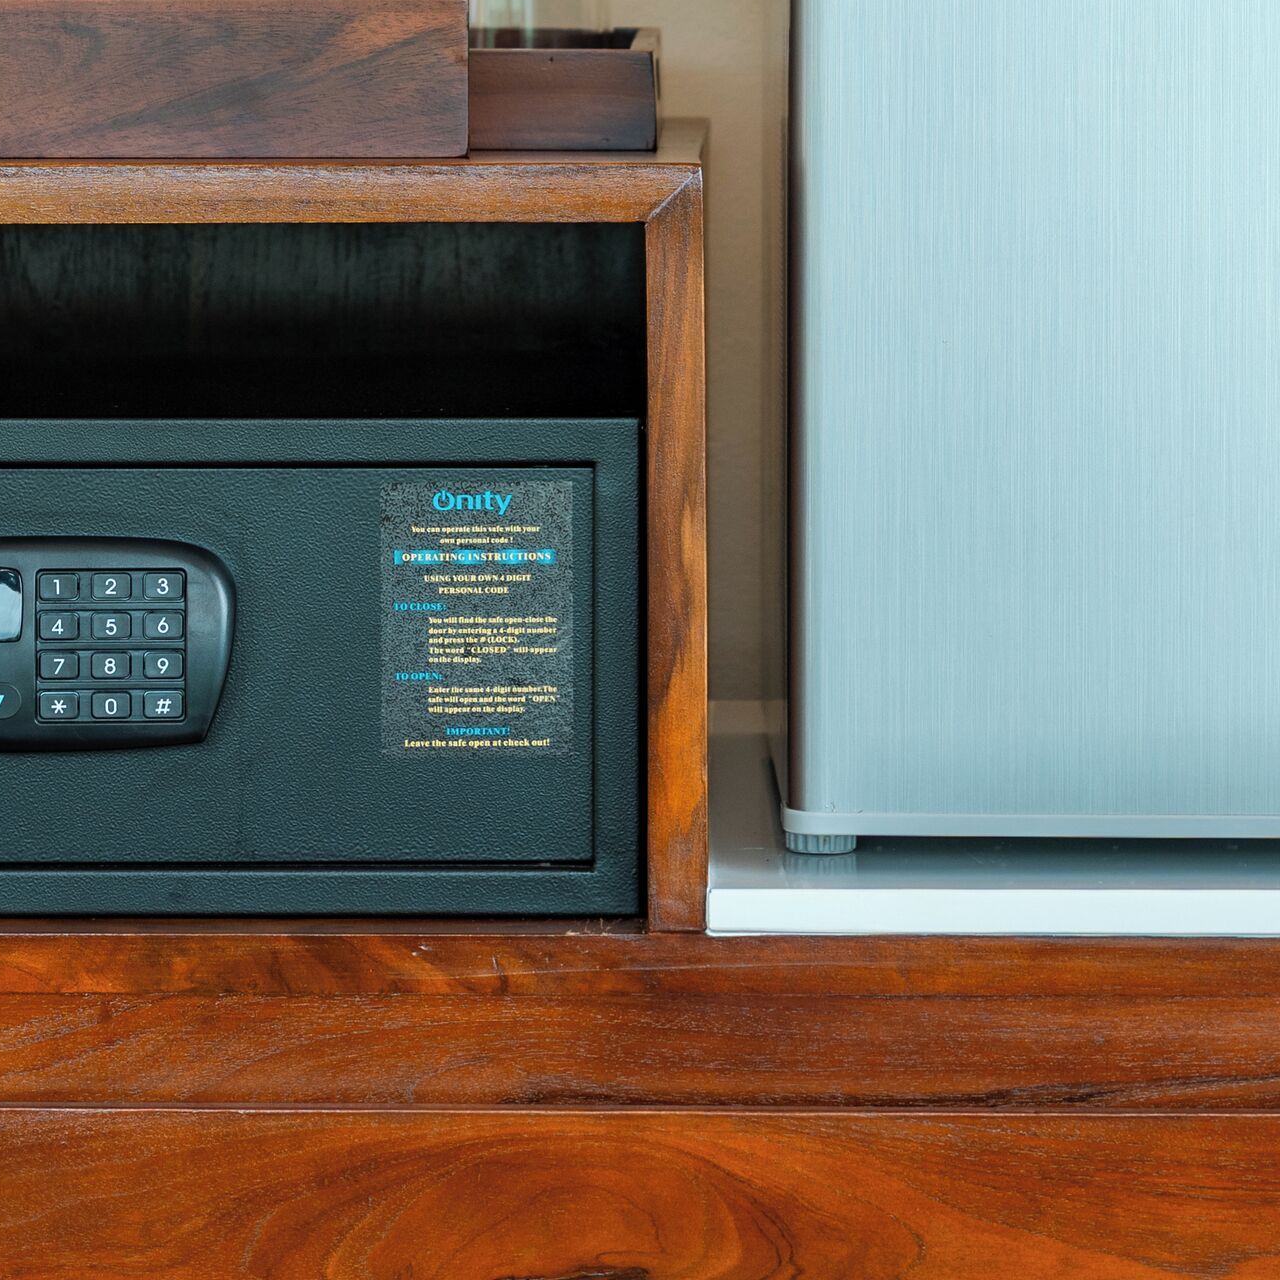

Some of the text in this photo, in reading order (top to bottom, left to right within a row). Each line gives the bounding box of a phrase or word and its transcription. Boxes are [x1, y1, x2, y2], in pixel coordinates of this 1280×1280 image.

[432, 490, 512, 516] Onity
[440, 537, 454, 545] own
[457, 537, 489, 545] personal
[491, 537, 508, 545] code
[402, 552, 551, 561] OPERATING INSTRUCTIONS
[54, 579, 169, 595] 1 2 3
[394, 602, 447, 610] TO CLOSE:
[52, 617, 169, 635] 4 5 6
[53, 658, 169, 674] 7 8 9
[428, 686, 449, 694] Enter
[451, 686, 463, 694] the
[465, 686, 484, 694] same
[486, 686, 510, 694] 4-digit
[105, 699, 117, 715] 0
[156, 699, 172, 714] #
[428, 706, 525, 714] will appear on the display.
[446, 727, 511, 735] IMPORTANT!
[432, 739, 446, 747] the
[448, 739, 466, 747] safe
[468, 740, 490, 748] open
[531, 738, 550, 746] out!
